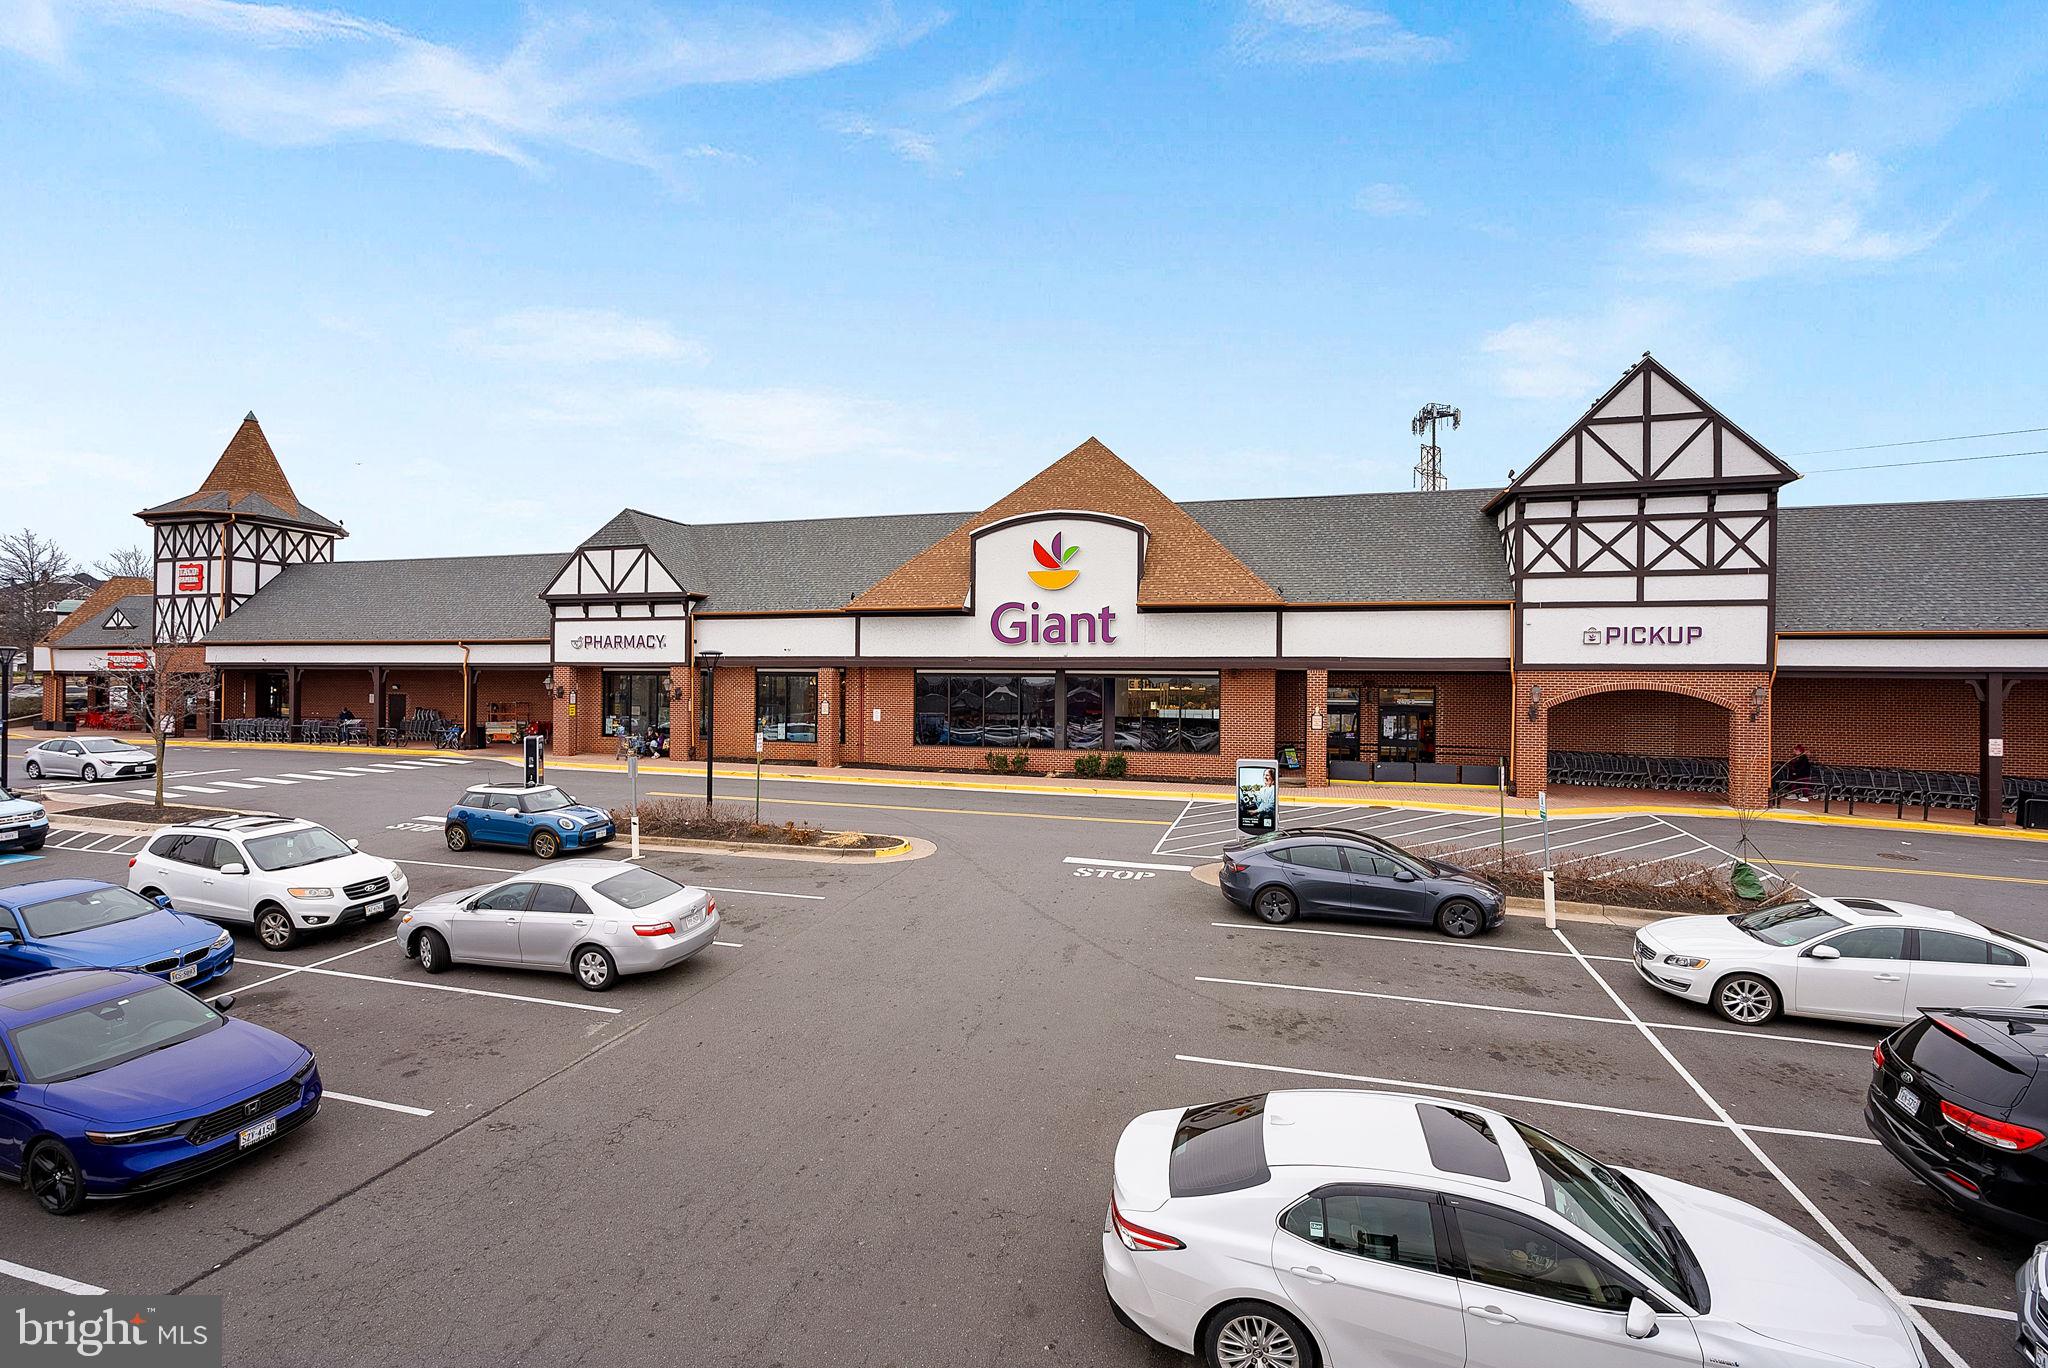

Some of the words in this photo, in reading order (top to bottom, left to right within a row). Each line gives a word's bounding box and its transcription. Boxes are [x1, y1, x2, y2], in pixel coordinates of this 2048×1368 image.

[990, 602, 1117, 645] Giant
[584, 634, 665, 649] PHARMACY
[1605, 626, 1703, 645] PICKUP
[1073, 867, 1156, 880] STOP
